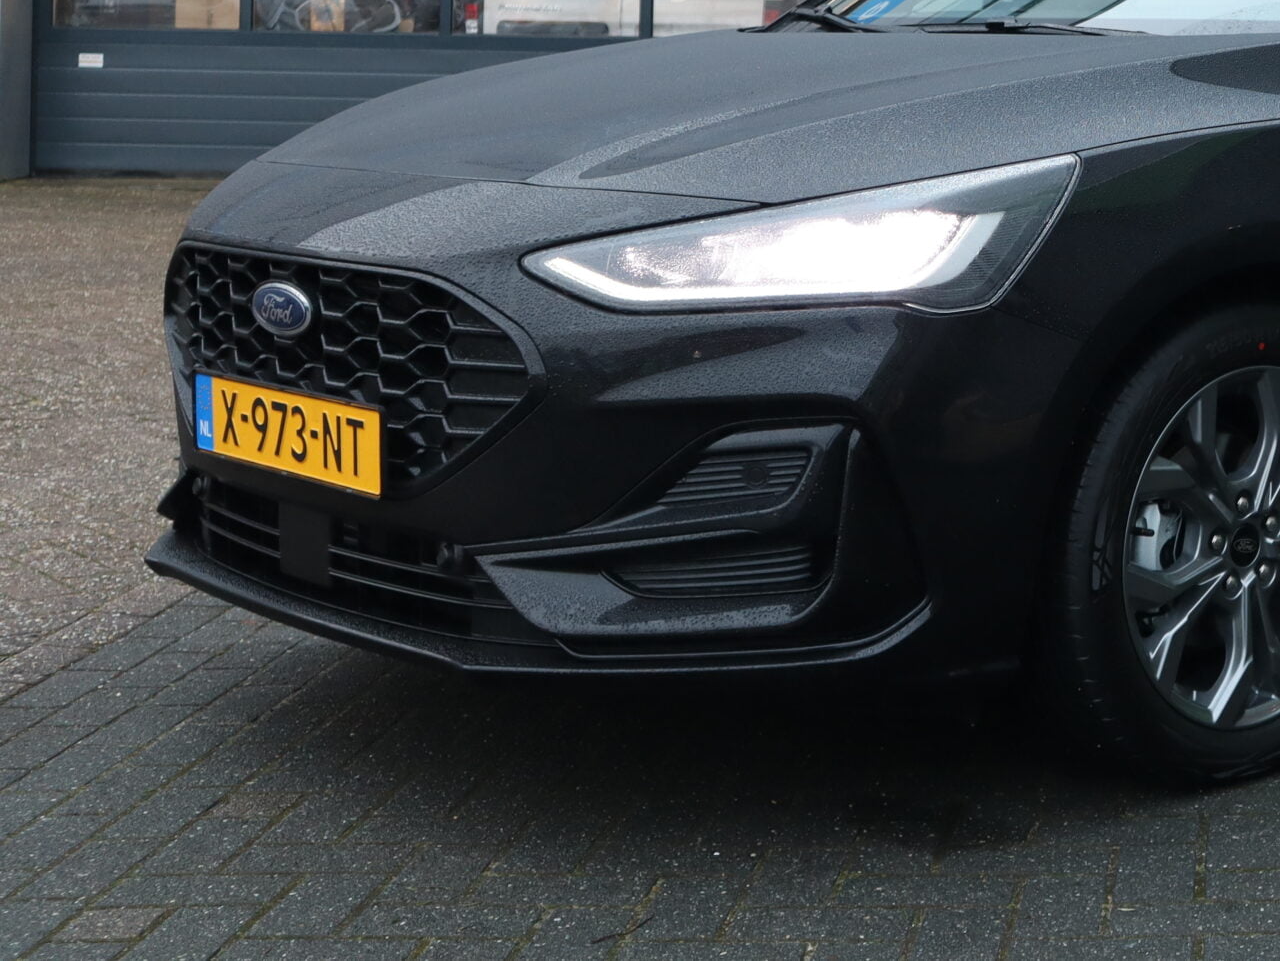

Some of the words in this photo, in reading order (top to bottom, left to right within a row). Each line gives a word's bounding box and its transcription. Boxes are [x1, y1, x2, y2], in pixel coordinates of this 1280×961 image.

[261, 293, 293, 324] Ford
[200, 420, 212, 437] NL
[221, 389, 364, 476] X-973-NT
